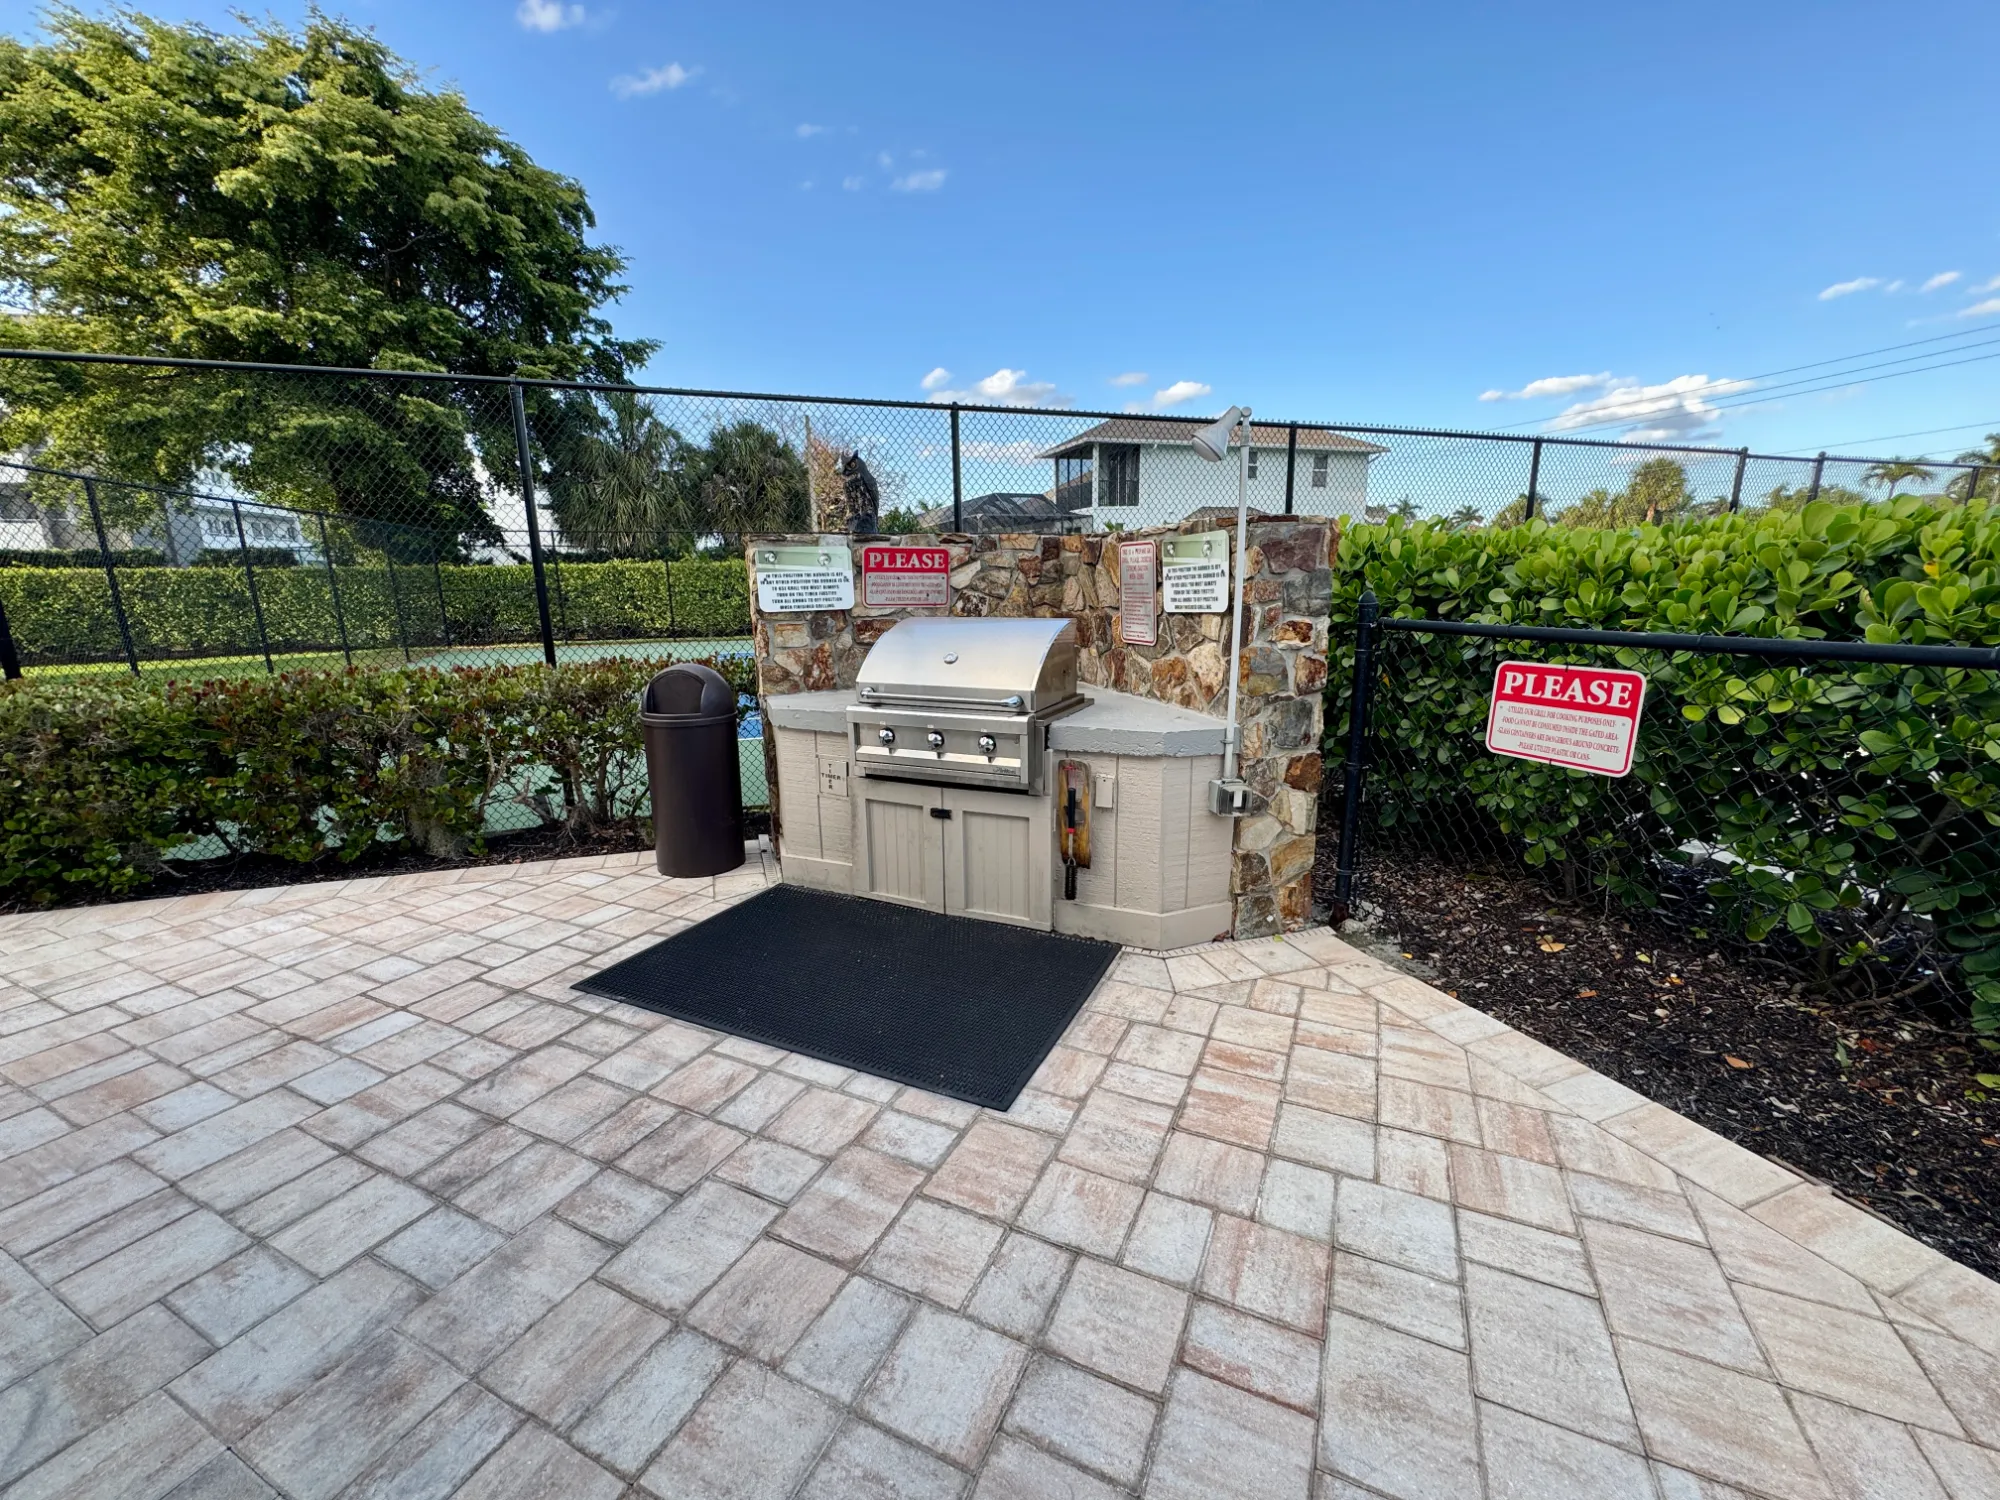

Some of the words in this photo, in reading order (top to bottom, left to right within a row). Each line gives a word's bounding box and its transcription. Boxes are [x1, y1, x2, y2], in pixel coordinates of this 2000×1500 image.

[868, 552, 945, 569] PLEASE
[1502, 671, 1632, 709] PLEASE
[1579, 728, 1589, 736] THE
